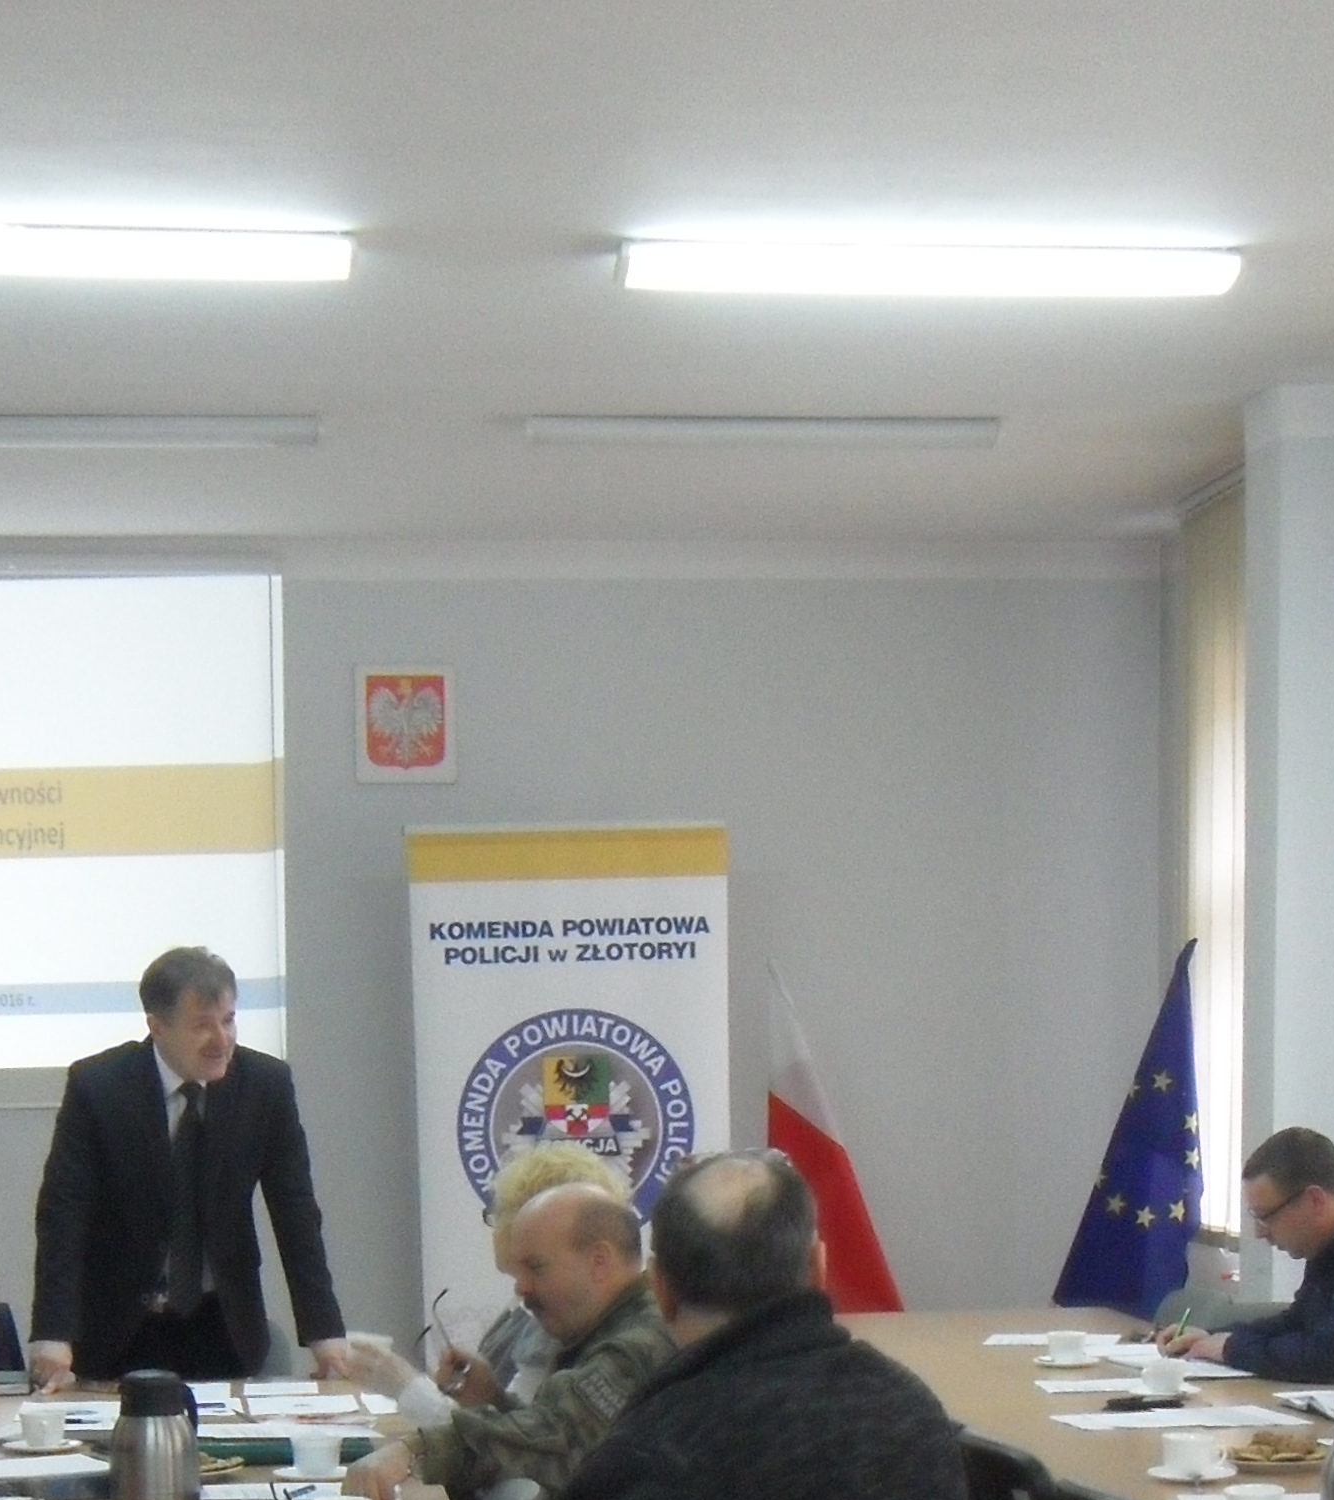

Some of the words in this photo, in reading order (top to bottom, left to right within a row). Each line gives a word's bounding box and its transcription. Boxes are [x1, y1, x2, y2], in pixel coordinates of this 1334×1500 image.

[429, 920, 554, 940] KOMENDA
[562, 916, 710, 937] POWIATOWA
[444, 946, 539, 965] POLICJI
[548, 949, 567, 963] w
[576, 941, 696, 961] ZŁOTORYI
[463, 1058, 507, 1193] KOMENDA
[503, 1014, 667, 1077] POWIATOWA
